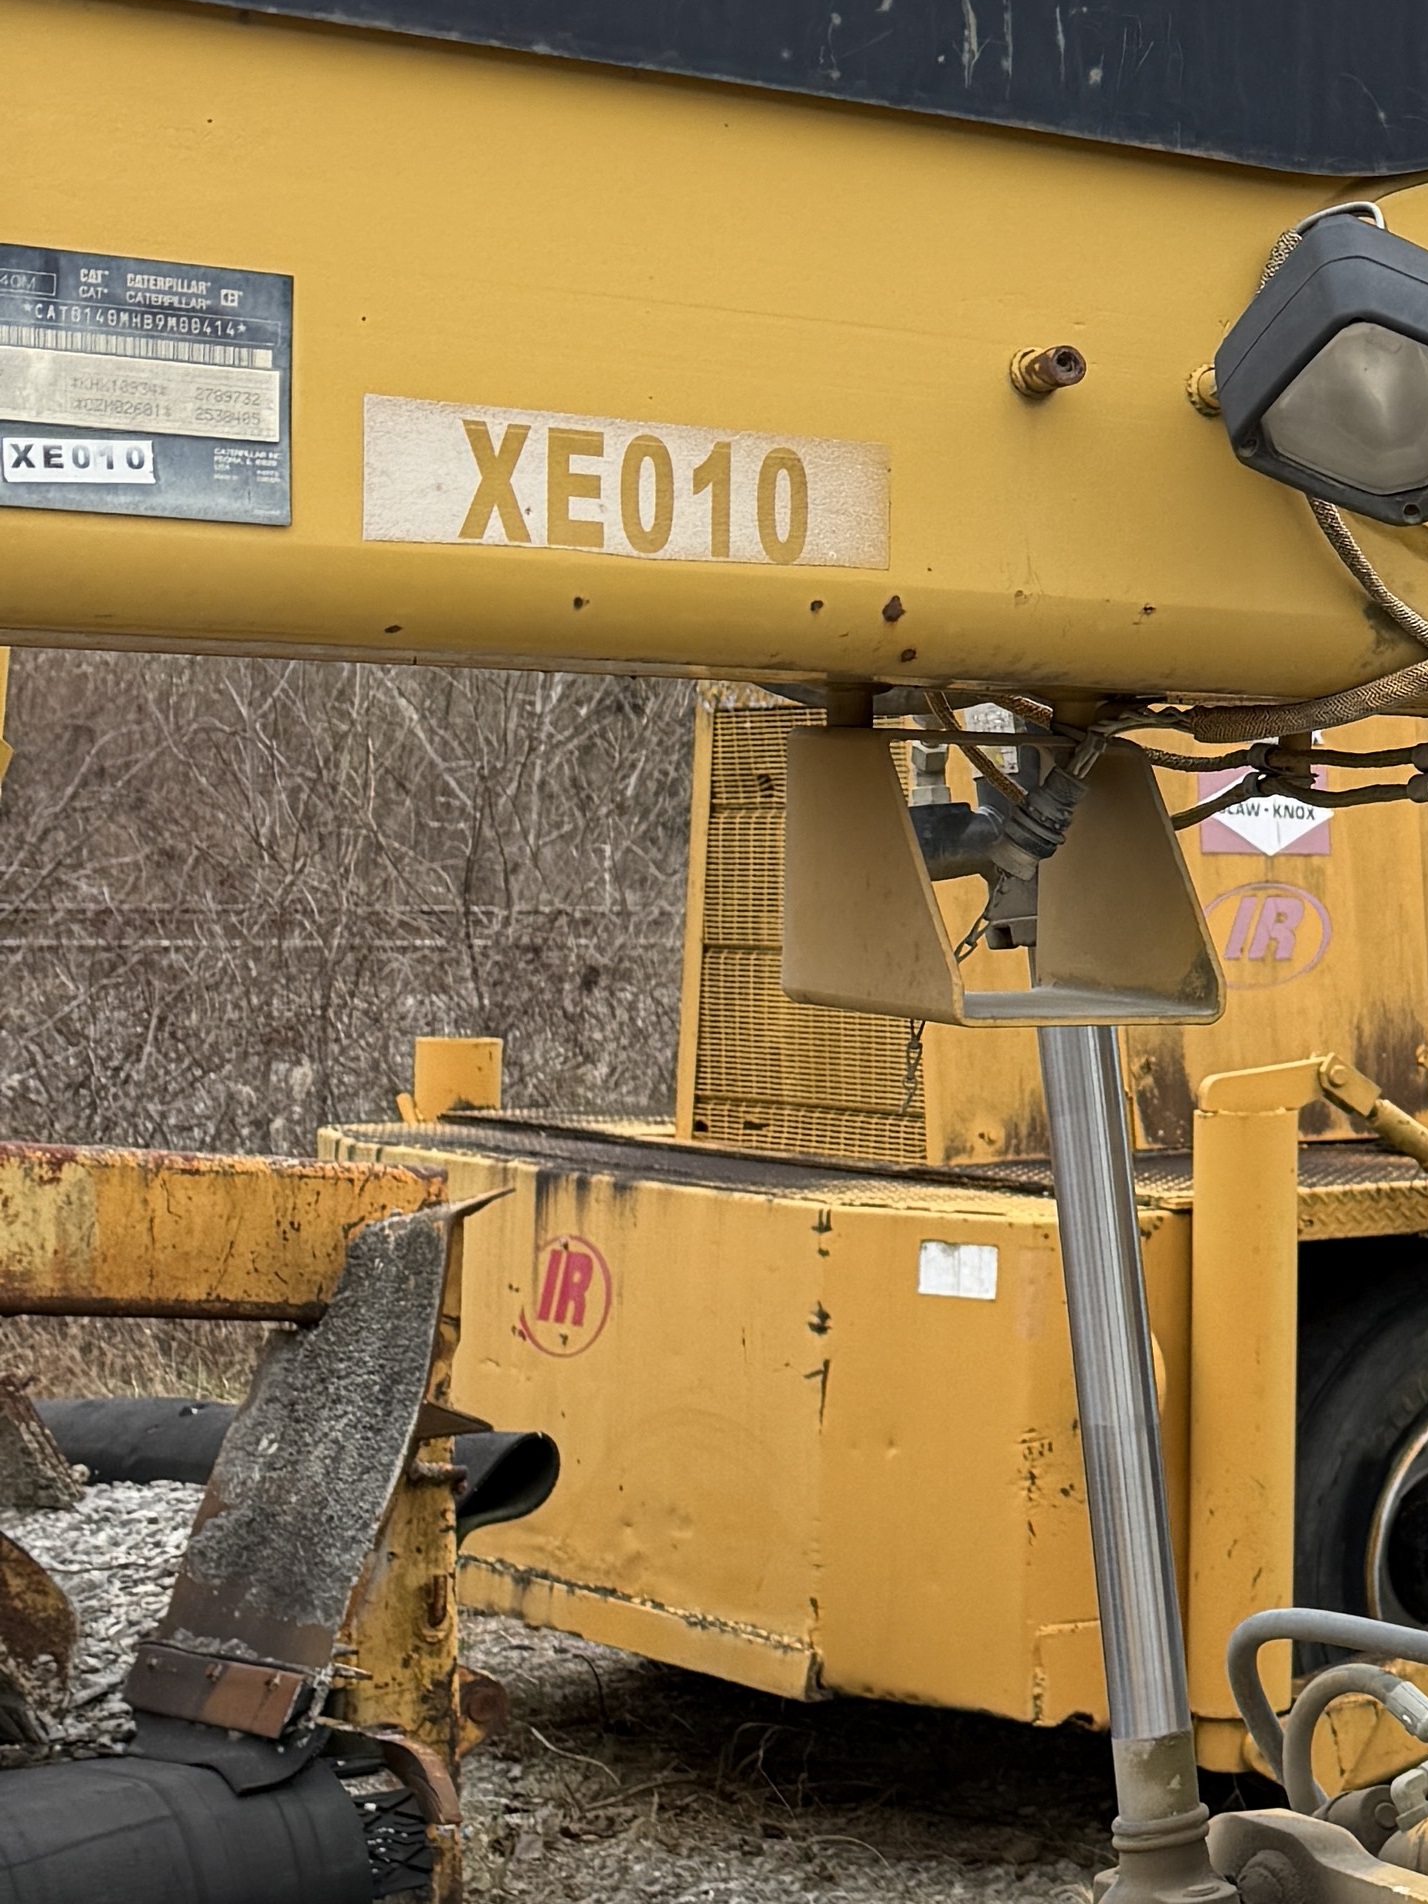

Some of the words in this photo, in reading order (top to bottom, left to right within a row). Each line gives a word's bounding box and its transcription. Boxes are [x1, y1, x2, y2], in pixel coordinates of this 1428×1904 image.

[80, 268, 104, 284] CAT
[126, 273, 207, 295] CATERPILLAR
[79, 286, 104, 299] CAT
[126, 291, 207, 310] CATERPILLAR
[11, 443, 145, 470] XE010
[458, 419, 808, 564] XE010
[1220, 802, 1260, 817] LAW
[1273, 804, 1315, 820] KNOX
